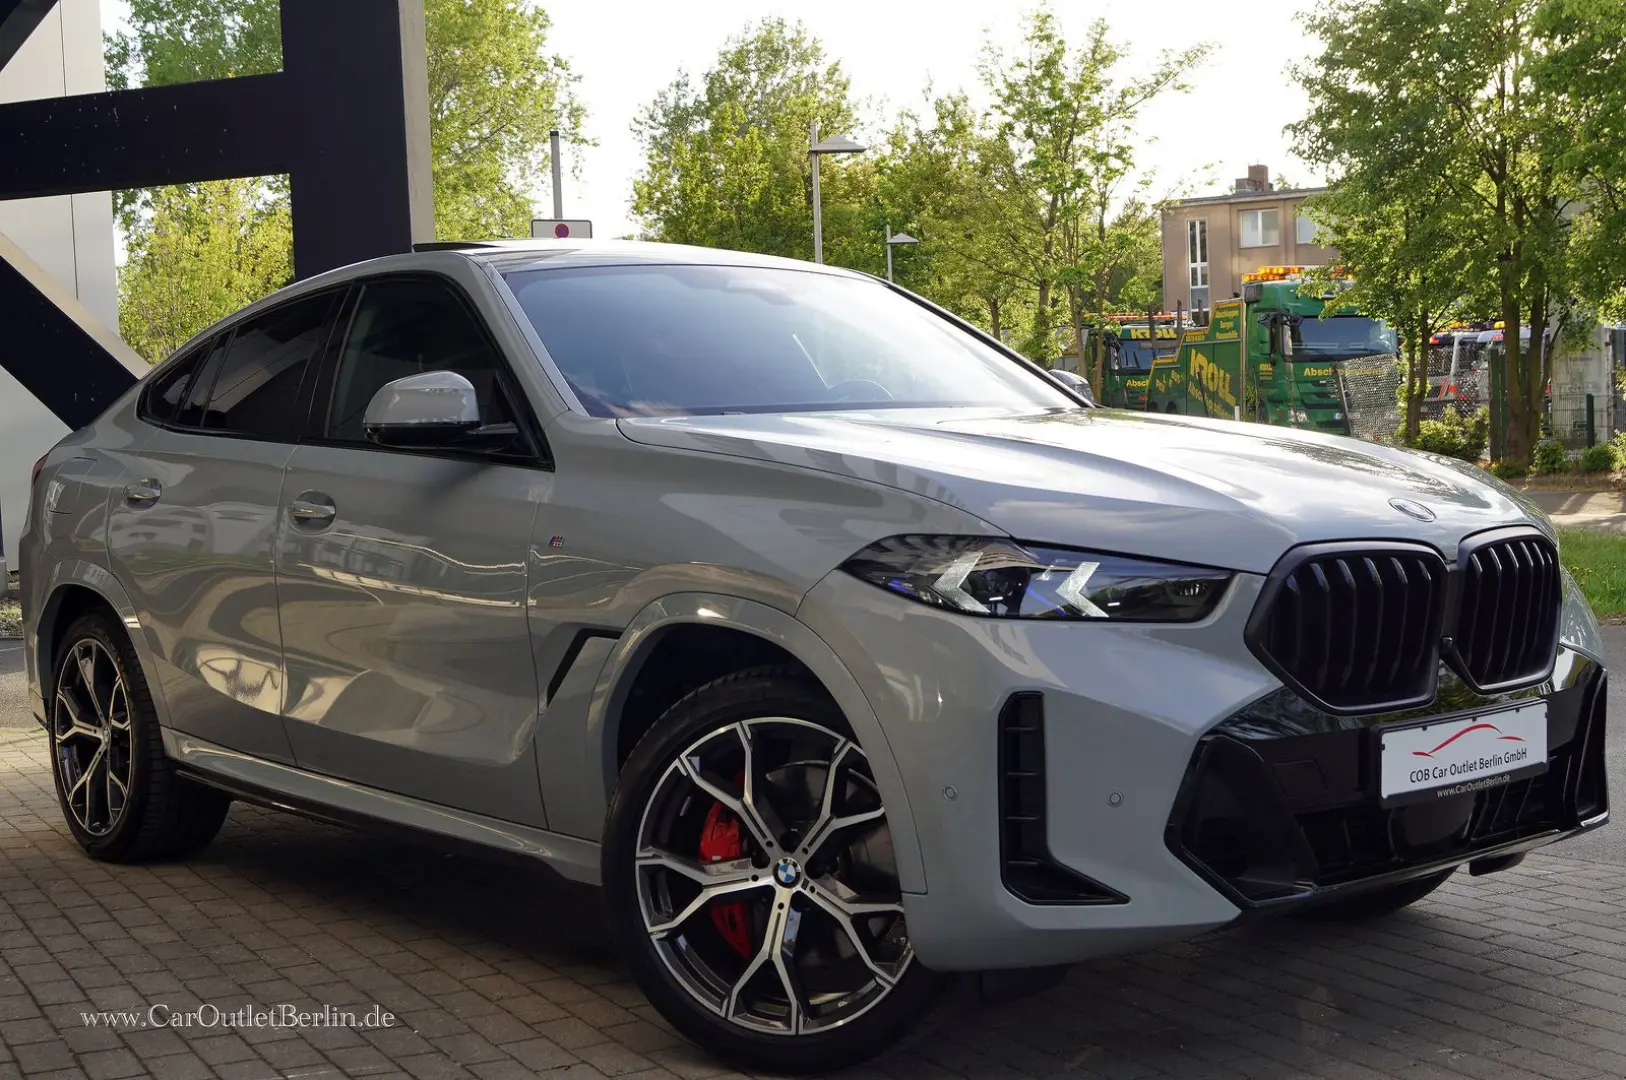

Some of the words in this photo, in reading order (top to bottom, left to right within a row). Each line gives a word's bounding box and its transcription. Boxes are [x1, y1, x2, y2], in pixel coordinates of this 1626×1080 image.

[1409, 768, 1430, 783] COB
[1432, 766, 1448, 779] Car
[1449, 759, 1478, 776] Outlet
[1479, 753, 1503, 770] Berlin
[1503, 747, 1528, 764] GmbH
[1436, 773, 1511, 798] www.CarOutletBerlin.de
